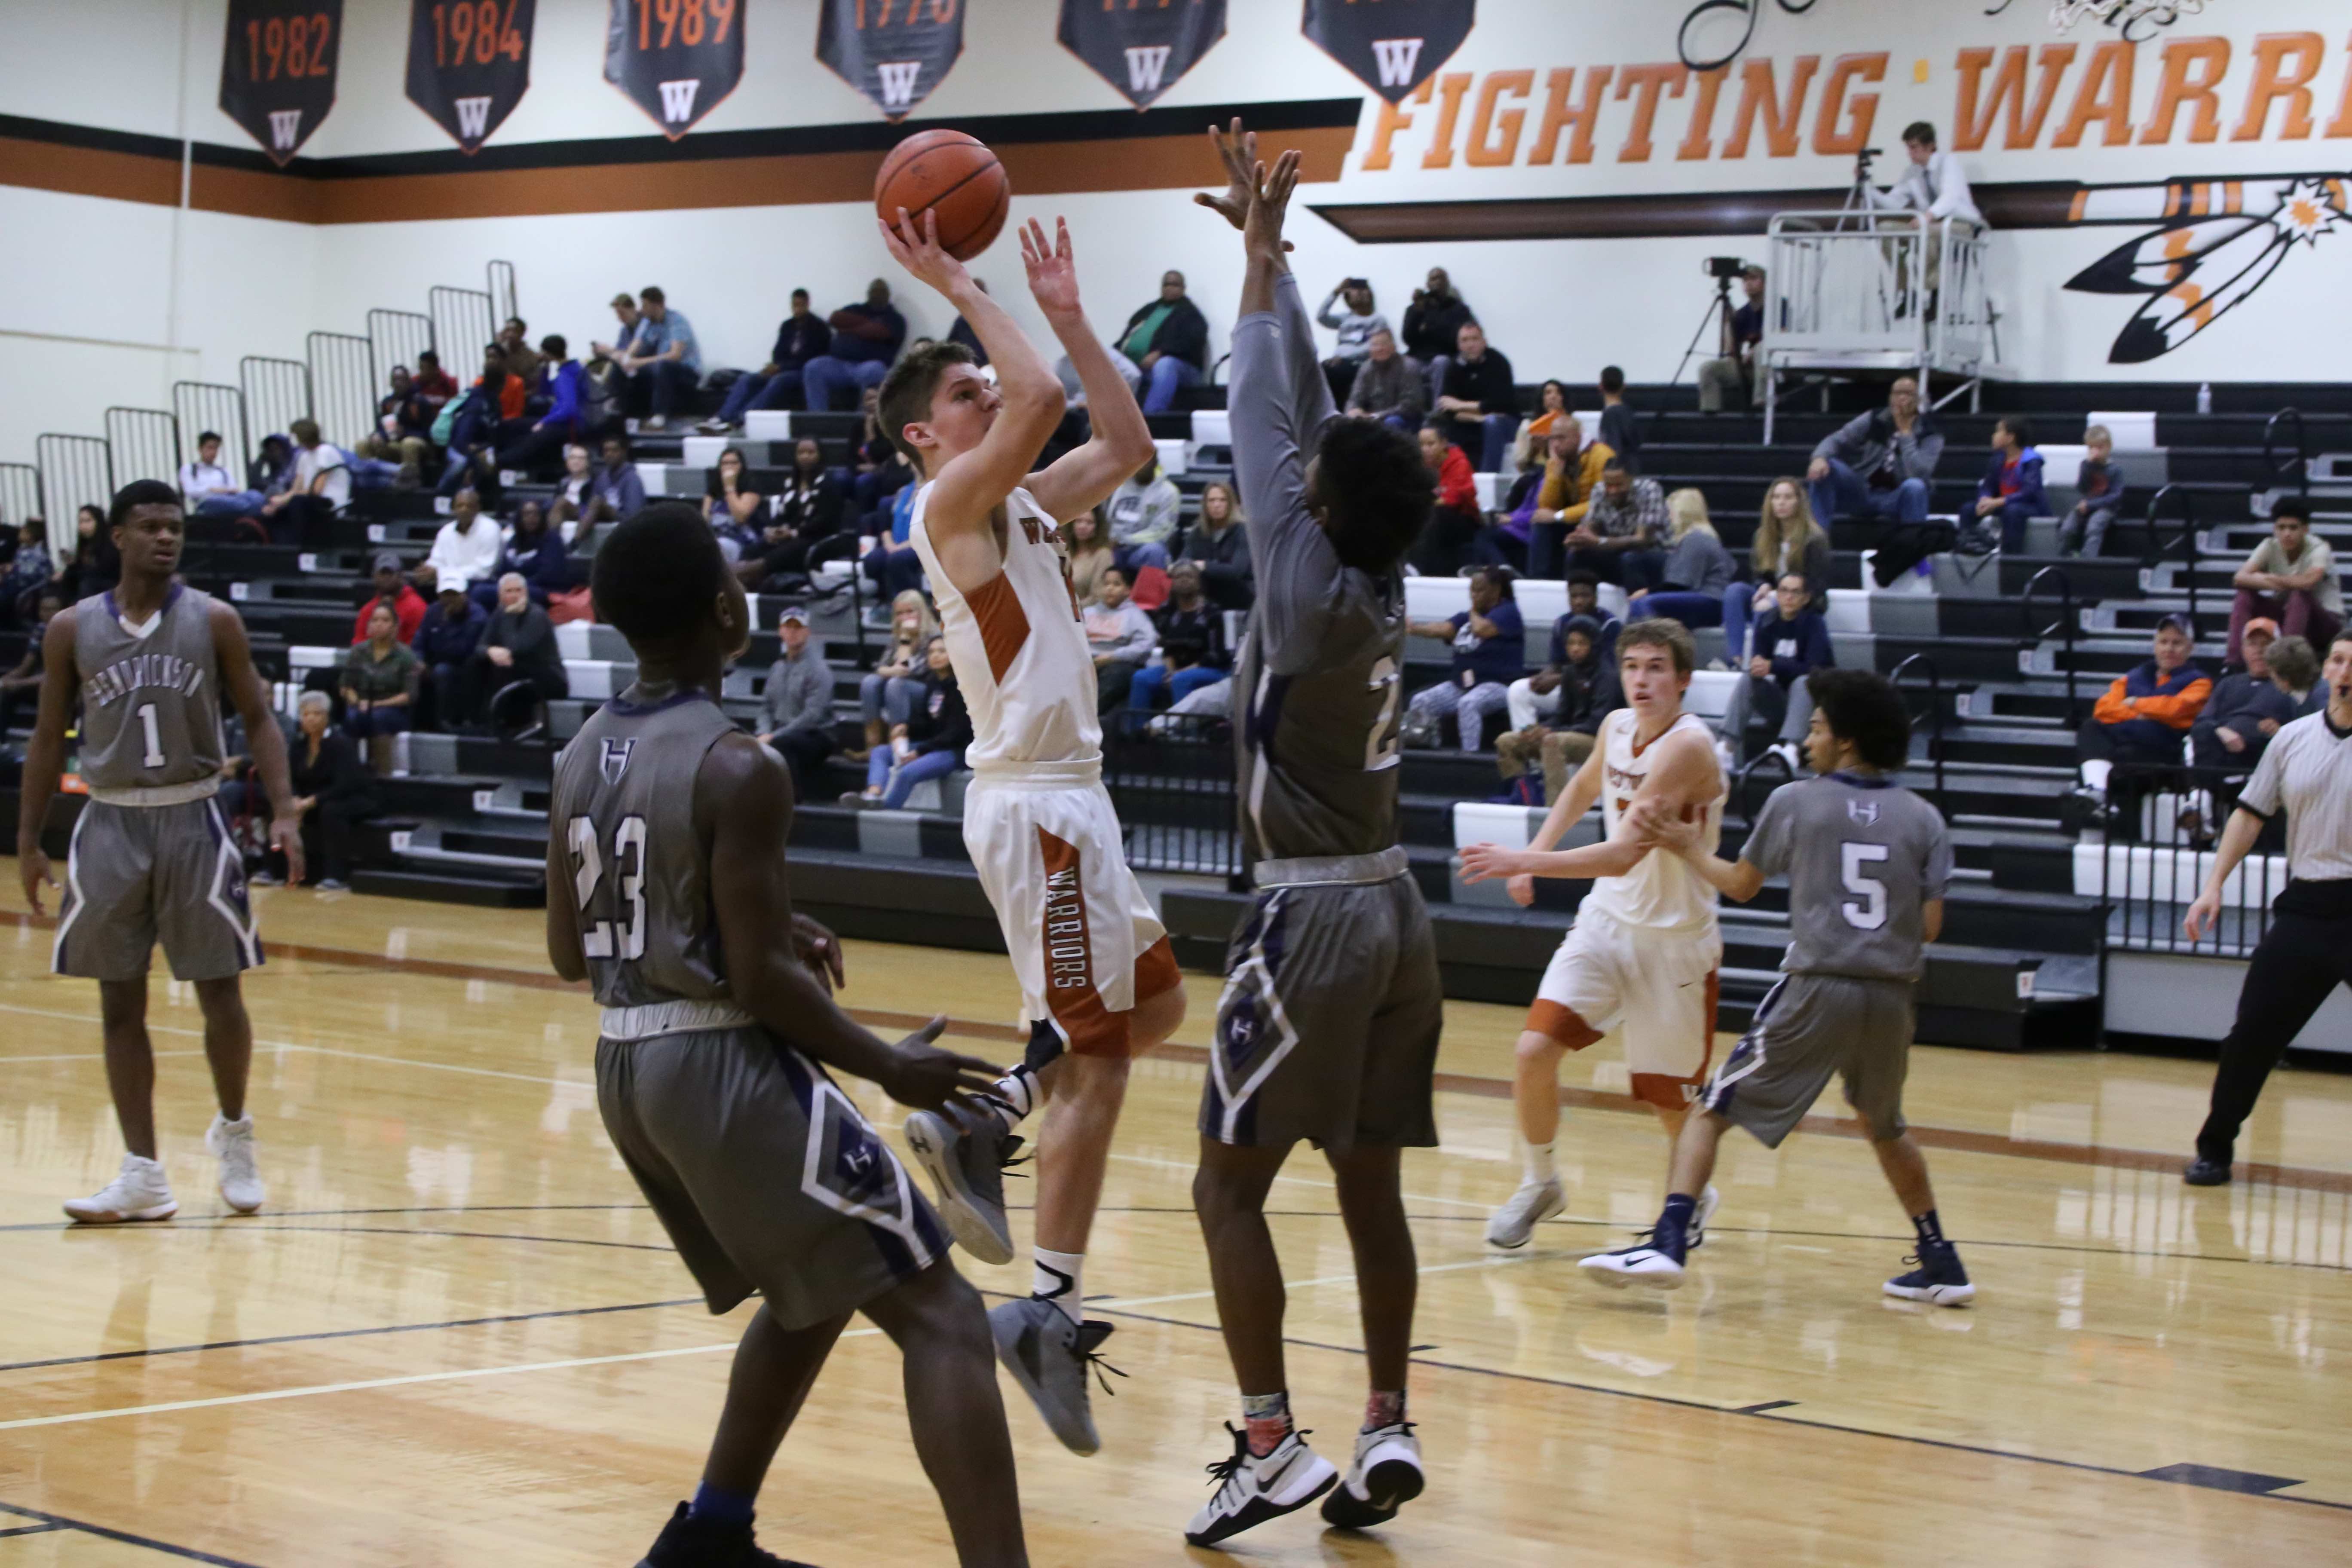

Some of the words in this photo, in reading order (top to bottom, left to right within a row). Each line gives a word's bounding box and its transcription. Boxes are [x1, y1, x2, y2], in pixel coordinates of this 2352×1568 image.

[247, 12, 330, 81] 1982
[433, 0, 524, 66] 1984
[1372, 37, 1424, 87] W
[658, 79, 701, 123] W
[878, 62, 921, 104] W
[1124, 45, 1172, 92] W
[268, 109, 302, 150] W
[454, 95, 493, 139] W
[1360, 51, 1890, 171] FIGHTING
[138, 703, 166, 768] 1
[1364, 655, 1401, 772] 2
[599, 737, 639, 785] H
[568, 815, 646, 961] 23
[1841, 841, 1889, 930] 5
[1046, 865, 1087, 989] WARRIORS
